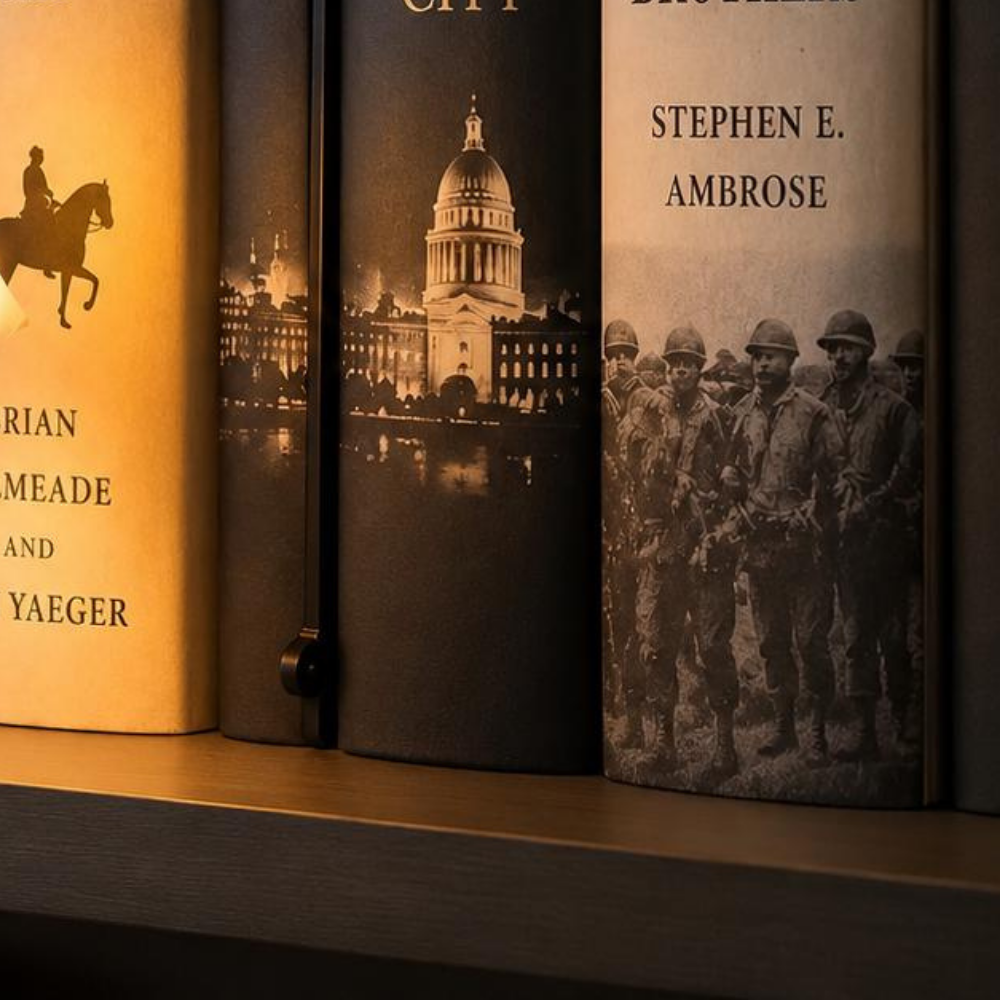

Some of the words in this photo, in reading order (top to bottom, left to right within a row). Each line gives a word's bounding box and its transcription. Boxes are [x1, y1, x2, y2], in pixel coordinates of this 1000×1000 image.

[650, 105, 802, 138] STEPHEN
[815, 105, 844, 138] E.
[664, 174, 828, 207] AMBROSE
[3, 535, 55, 558] AND
[7, 592, 129, 627] YAEGER
